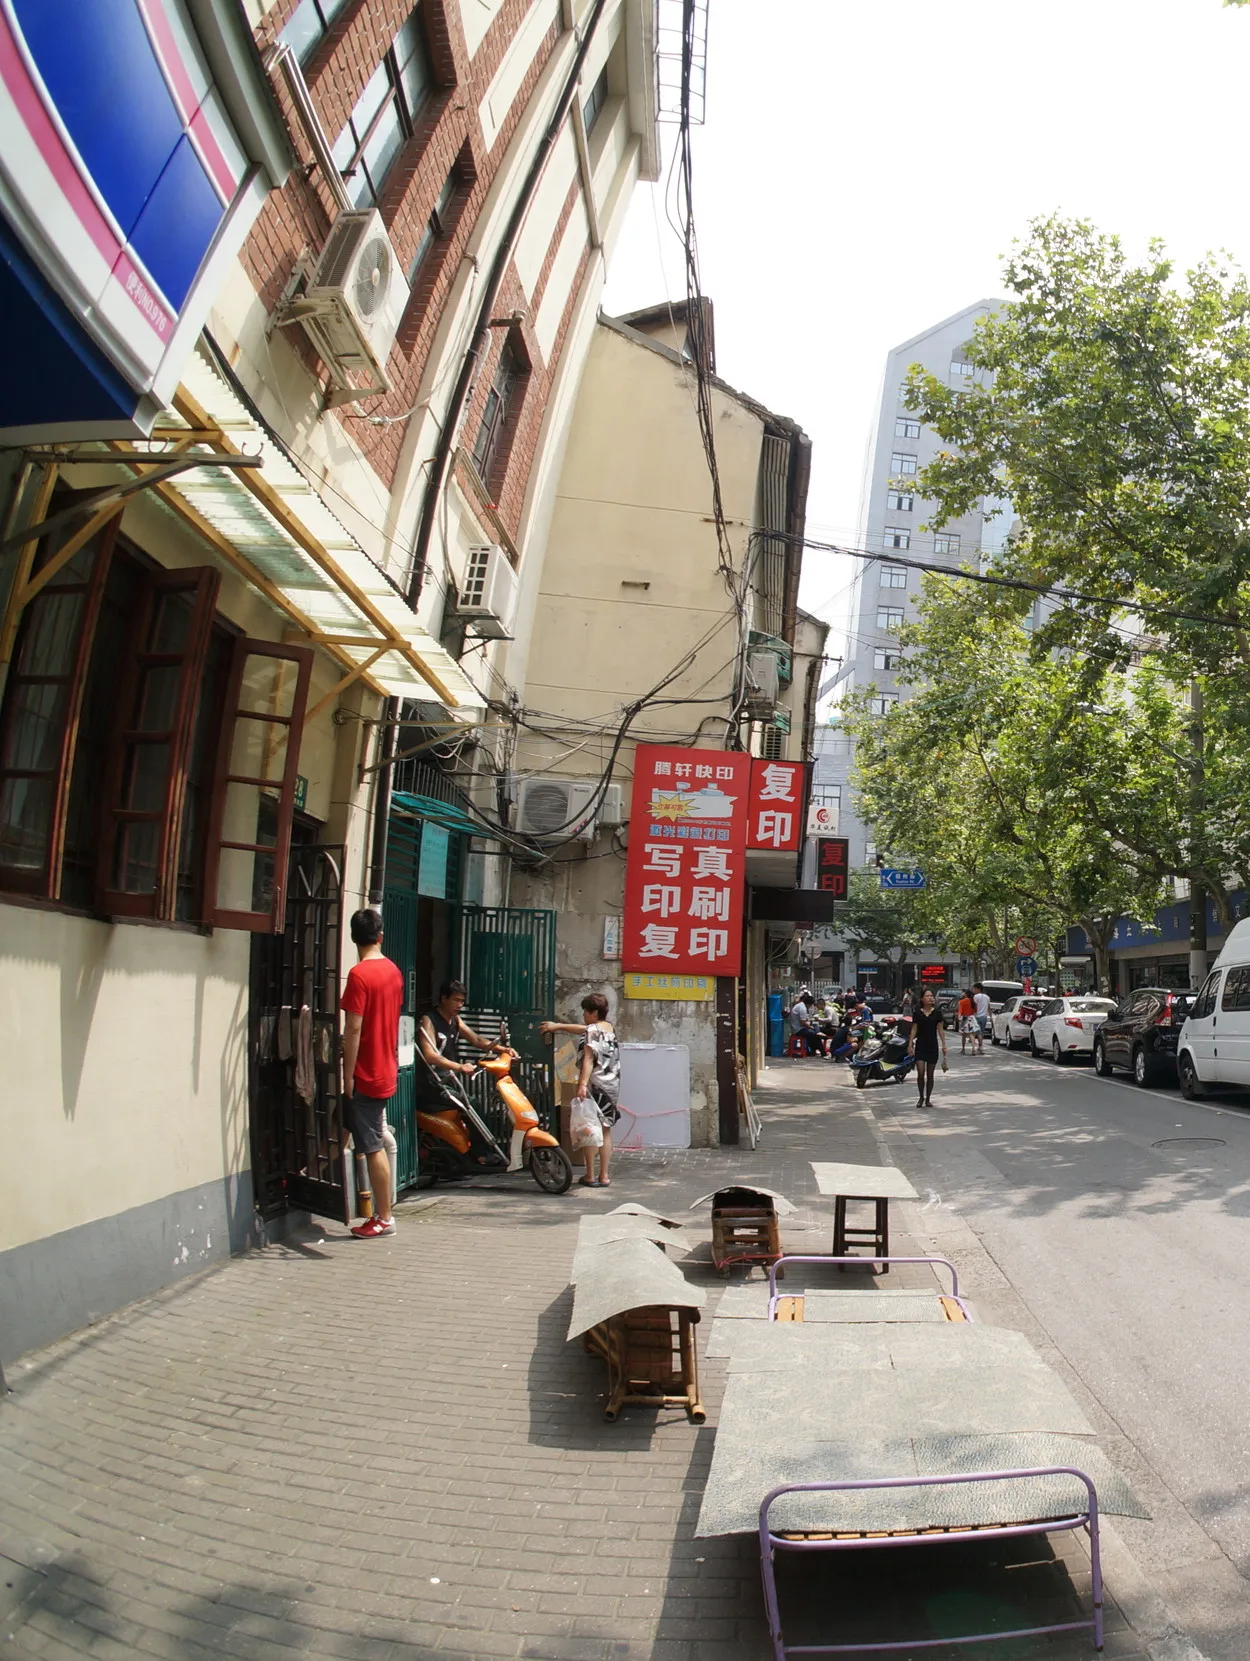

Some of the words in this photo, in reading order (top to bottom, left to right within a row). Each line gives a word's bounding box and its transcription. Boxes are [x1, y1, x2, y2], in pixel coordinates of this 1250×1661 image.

[654, 761, 734, 780] 腾轩快印
[756, 763, 796, 848] 复印
[642, 843, 733, 881] 写真
[821, 843, 845, 897] 复印
[640, 884, 731, 922] 印刷
[638, 923, 729, 962] 复印
